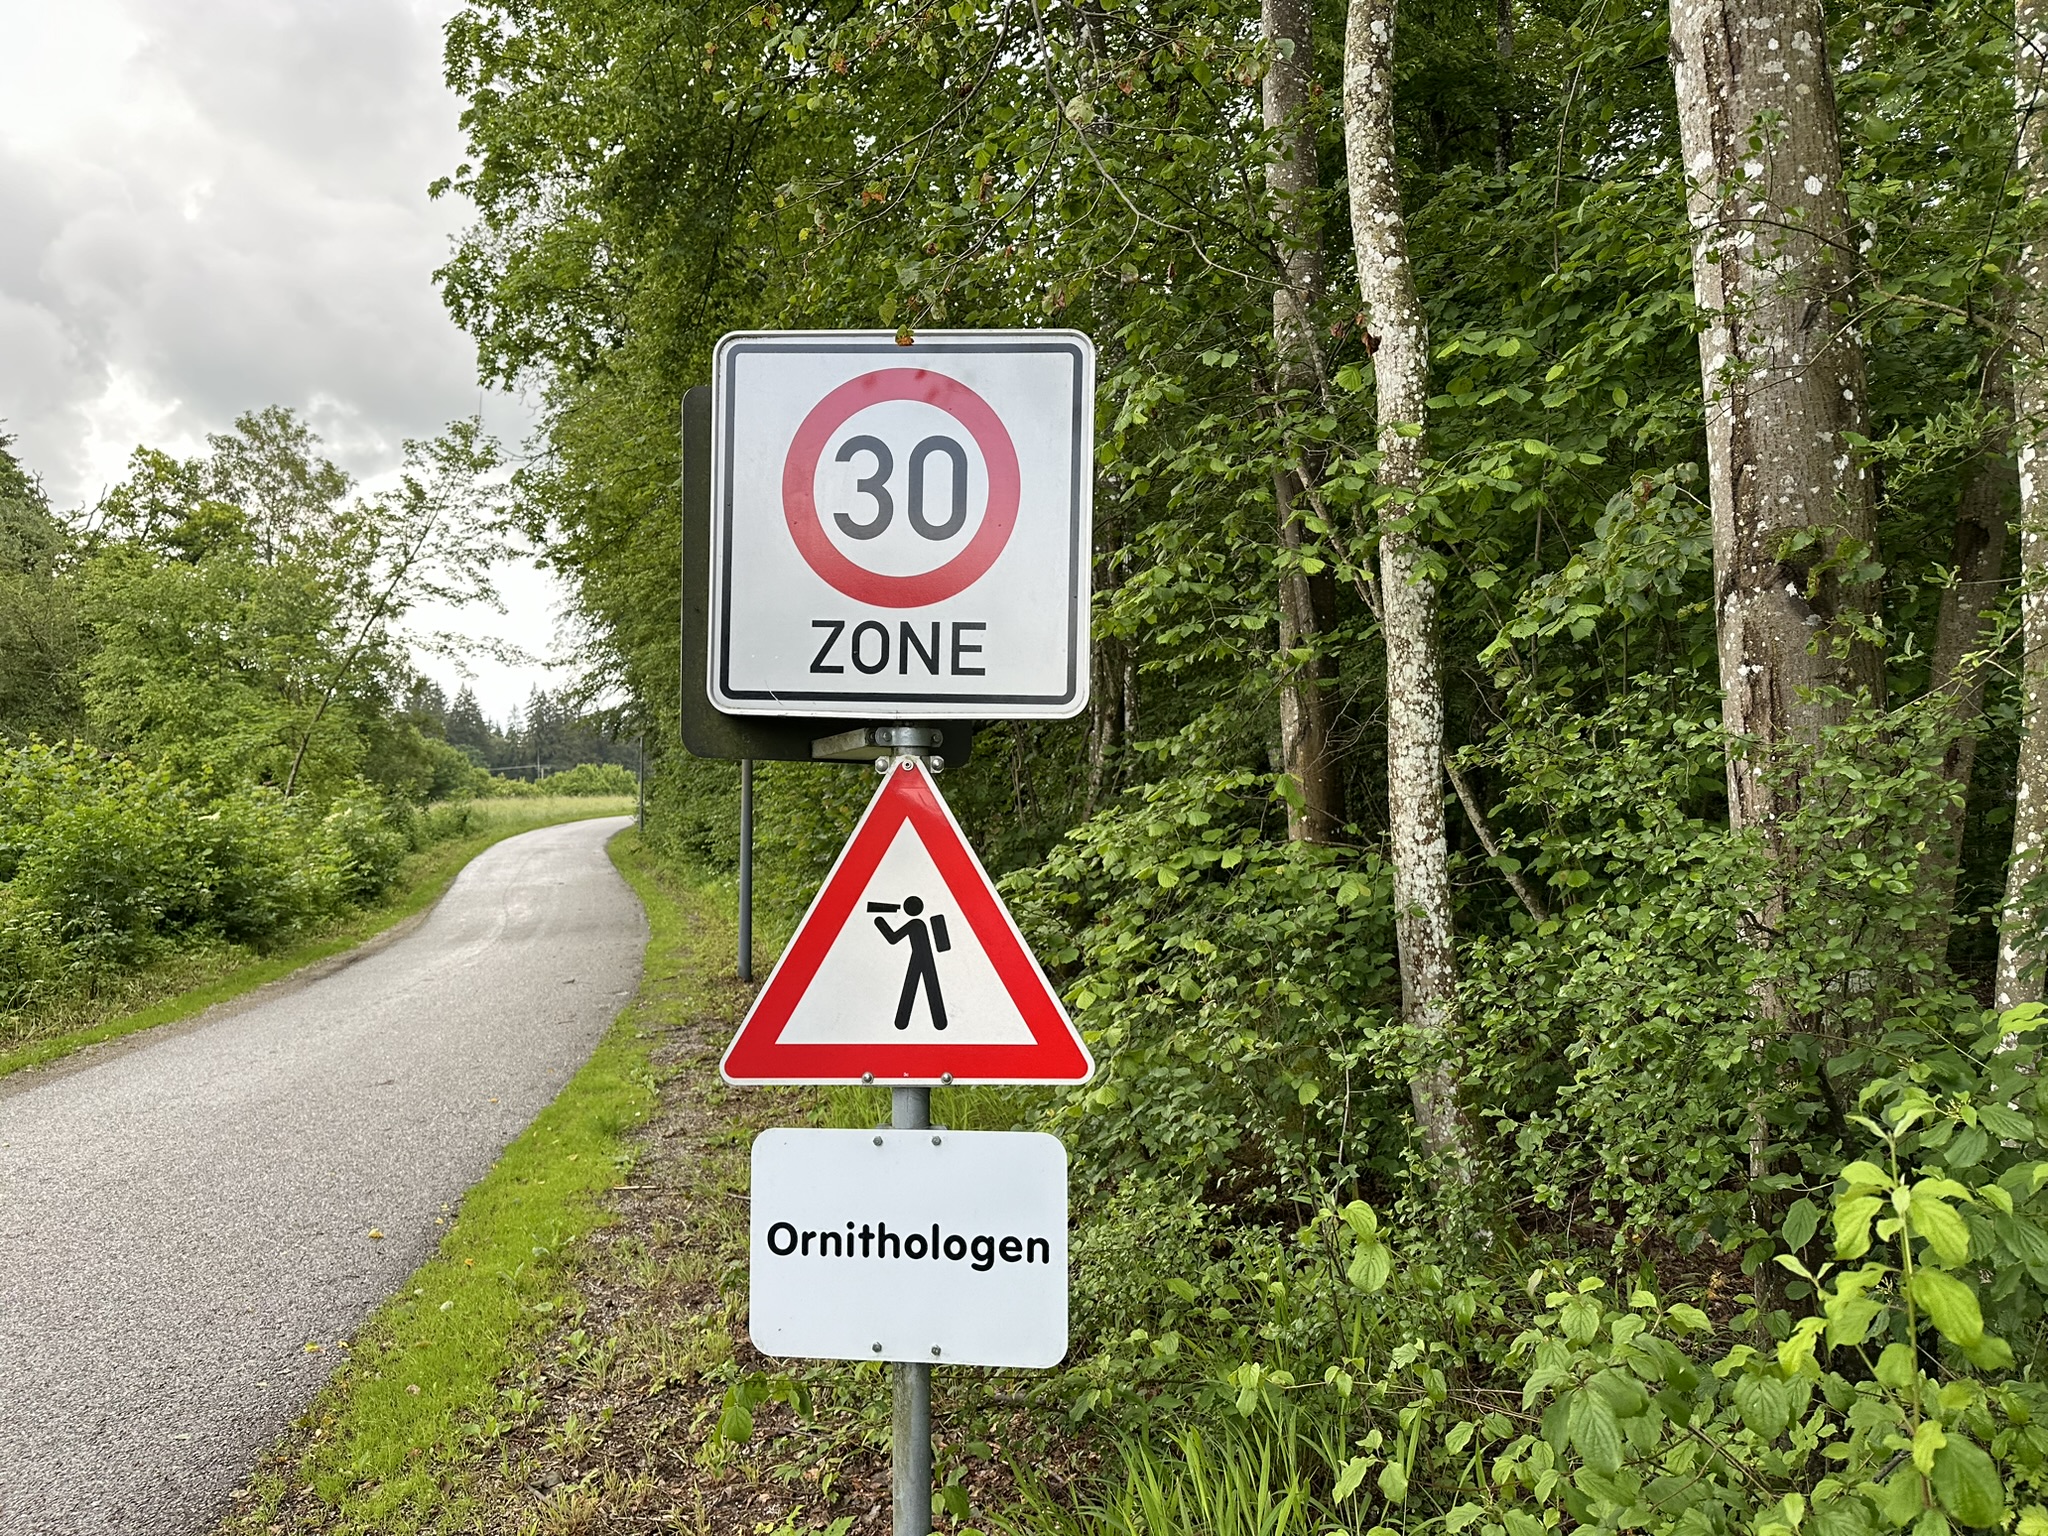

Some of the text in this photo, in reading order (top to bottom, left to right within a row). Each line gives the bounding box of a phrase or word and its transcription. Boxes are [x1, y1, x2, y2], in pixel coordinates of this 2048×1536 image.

[833, 435, 968, 541] 30
[809, 619, 987, 676] ZONE
[767, 1221, 1050, 1272] Ornithologen
